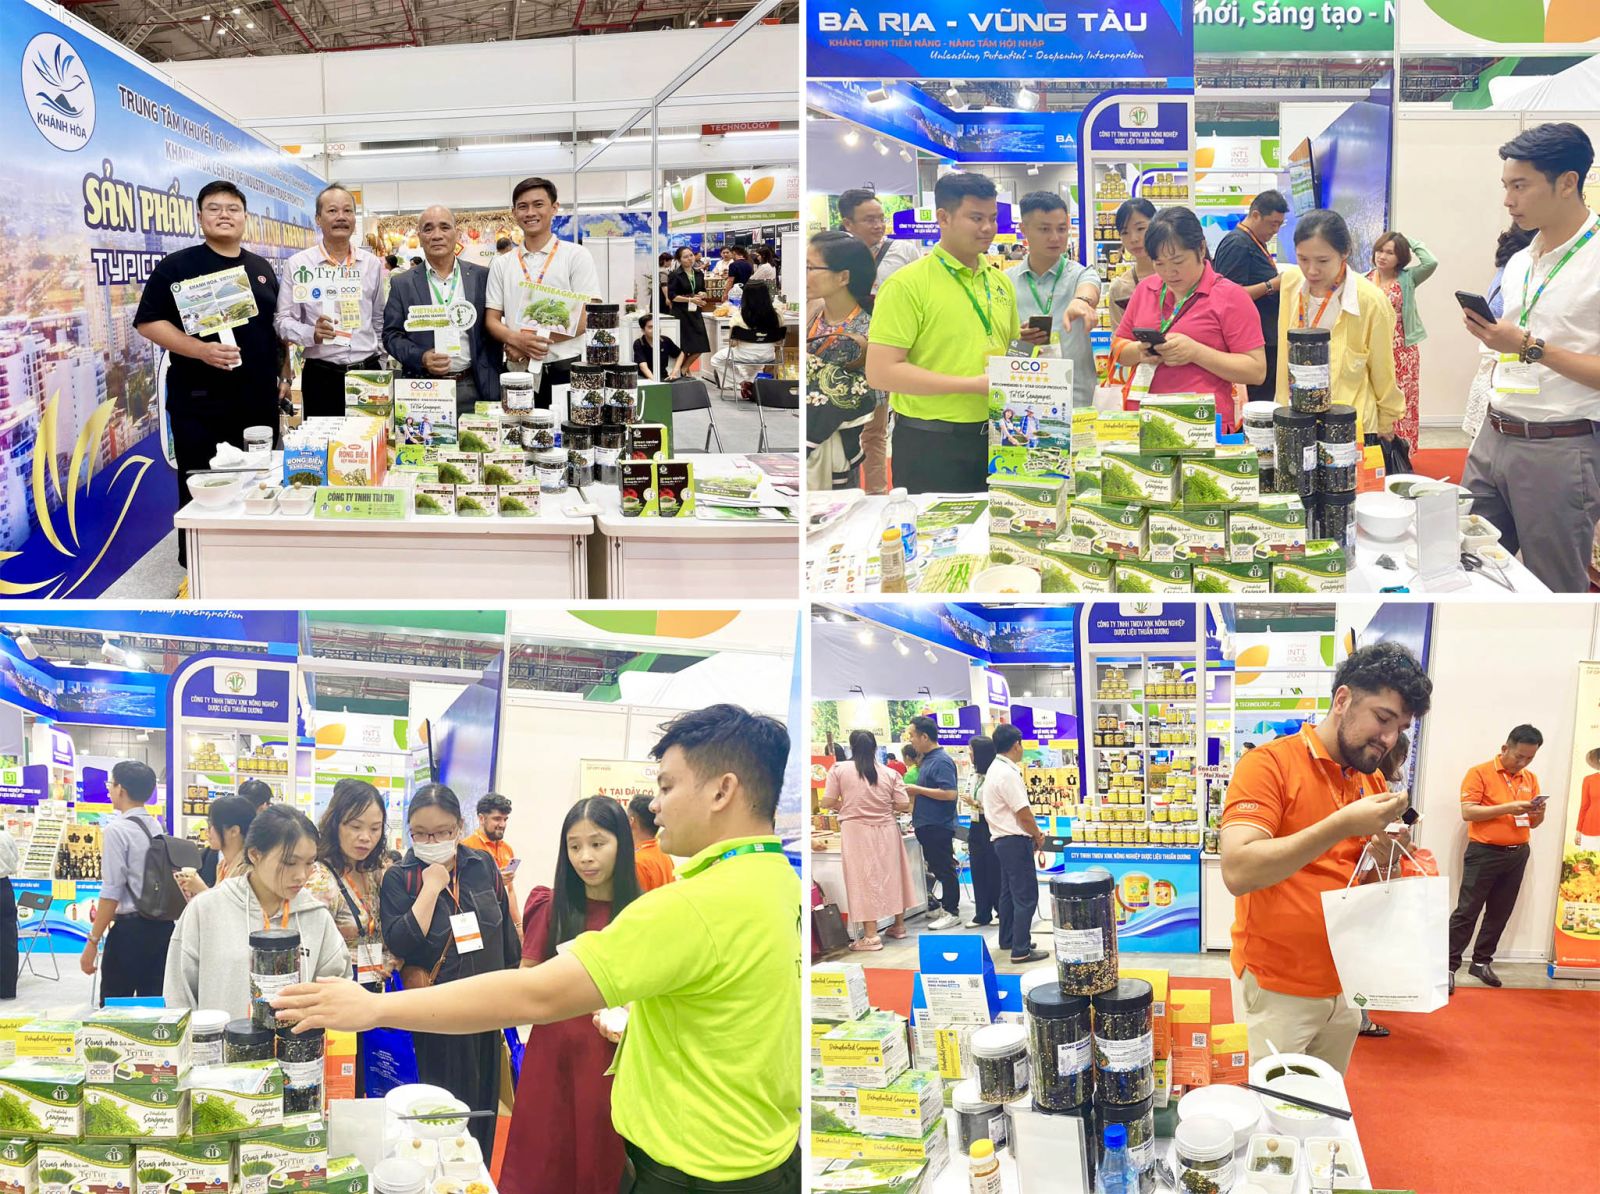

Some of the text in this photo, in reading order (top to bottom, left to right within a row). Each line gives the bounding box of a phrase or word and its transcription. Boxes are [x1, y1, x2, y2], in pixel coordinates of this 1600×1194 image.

[1253, 1, 1315, 30] Sáng
[1321, 4, 1363, 30] tạo
[818, 7, 868, 32] BÀ
[879, 12, 935, 35] RỊA
[968, 7, 1067, 32] VŨNG
[1077, 7, 1148, 32] TÀU
[864, 38, 889, 48] ĐỊNH
[930, 50, 980, 62] Unleashing
[983, 50, 1027, 60] Potential
[1036, 51, 1085, 62] Deepening
[1086, 50, 1144, 62] Intergration
[118, 85, 159, 122] TRUNG
[160, 105, 181, 130] TÂM
[37, 111, 87, 139] KHÁNH HÒA
[710, 122, 771, 131] TECHNOLOGY
[1055, 133, 1074, 143] BÀ
[84, 159, 136, 232] SẢN
[138, 177, 196, 238] PHẨM
[1011, 361, 1048, 372] OCOP
[411, 381, 439, 390] OCOP
[1188, 430, 1213, 440] Seagrapes
[1231, 483, 1257, 494] Seagrapes
[346, 492, 354, 502] TY
[1097, 620, 1109, 628] CÔNG
[1155, 619, 1167, 627] NÔNG
[1168, 619, 1185, 628] NGHIỆP
[85, 1037, 118, 1047] Rong nho
[829, 1043, 855, 1051] Dehydrated
[867, 1093, 893, 1103] Dehydrated
[251, 1105, 280, 1116] Seagrapes
[45, 1111, 74, 1125] Seagrapes
[143, 1113, 174, 1126] Seagrapes
[242, 1151, 273, 1162] Rong nho
[40, 1160, 73, 1170] Rong nho
[138, 1159, 171, 1169] Rong nho
